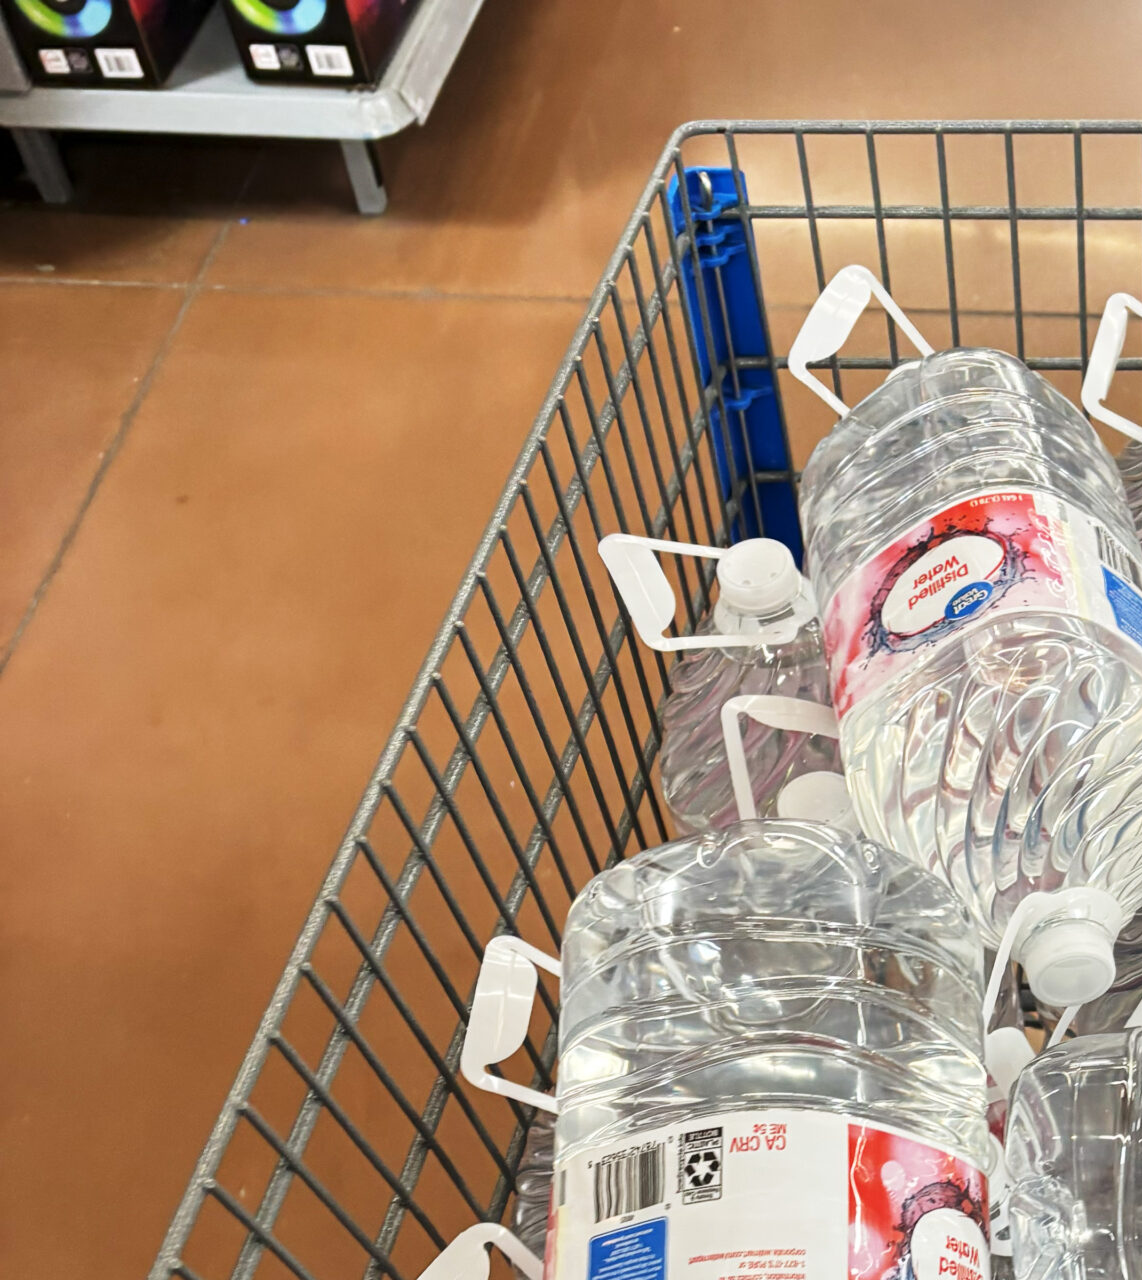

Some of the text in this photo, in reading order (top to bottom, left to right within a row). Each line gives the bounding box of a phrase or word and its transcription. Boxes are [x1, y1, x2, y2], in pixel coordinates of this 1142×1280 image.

[912, 555, 959, 590] Water
[908, 564, 968, 610] Distilled
[953, 589, 988, 614] Great
[770, 1124, 787, 1134] ME
[729, 1135, 786, 1153] CA CRV
[945, 1236, 979, 1268] Water
